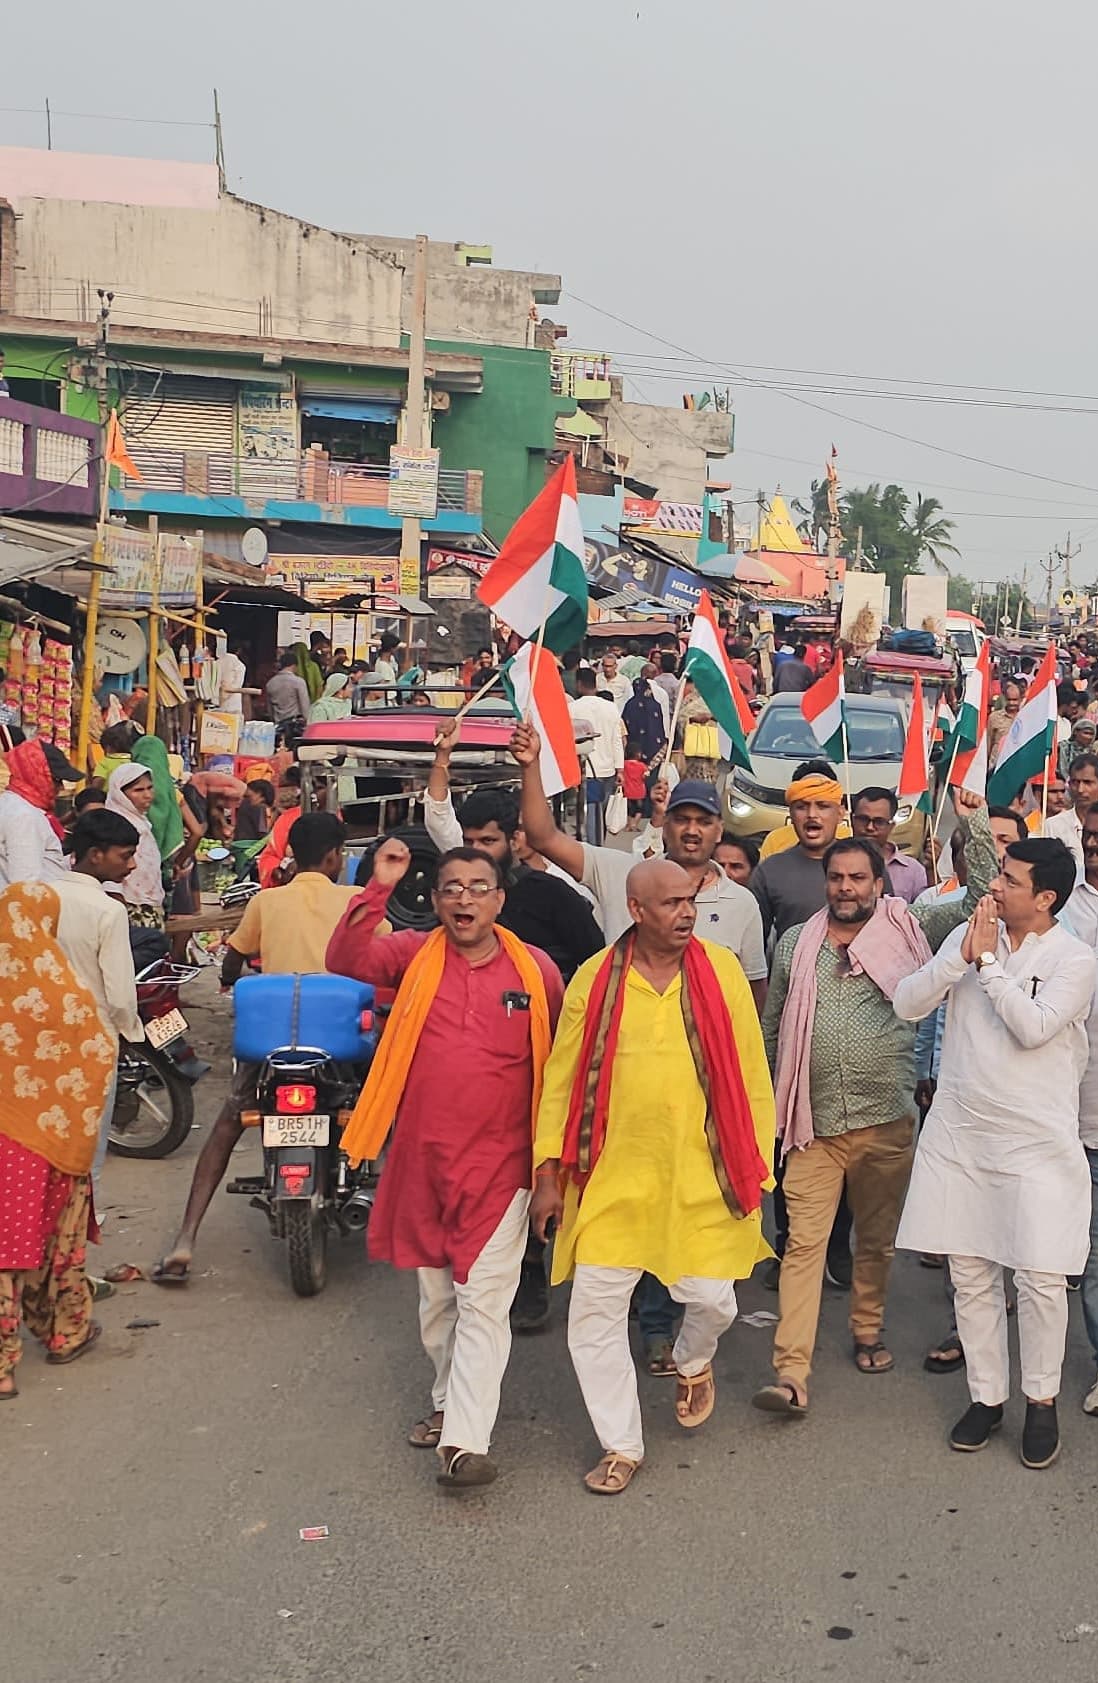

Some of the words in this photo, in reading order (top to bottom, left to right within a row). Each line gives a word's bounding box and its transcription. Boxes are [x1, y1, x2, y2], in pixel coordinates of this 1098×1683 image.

[671, 580, 701, 597] HELLO
[277, 1117, 322, 1130] BR51H
[280, 1131, 316, 1144] 2544
